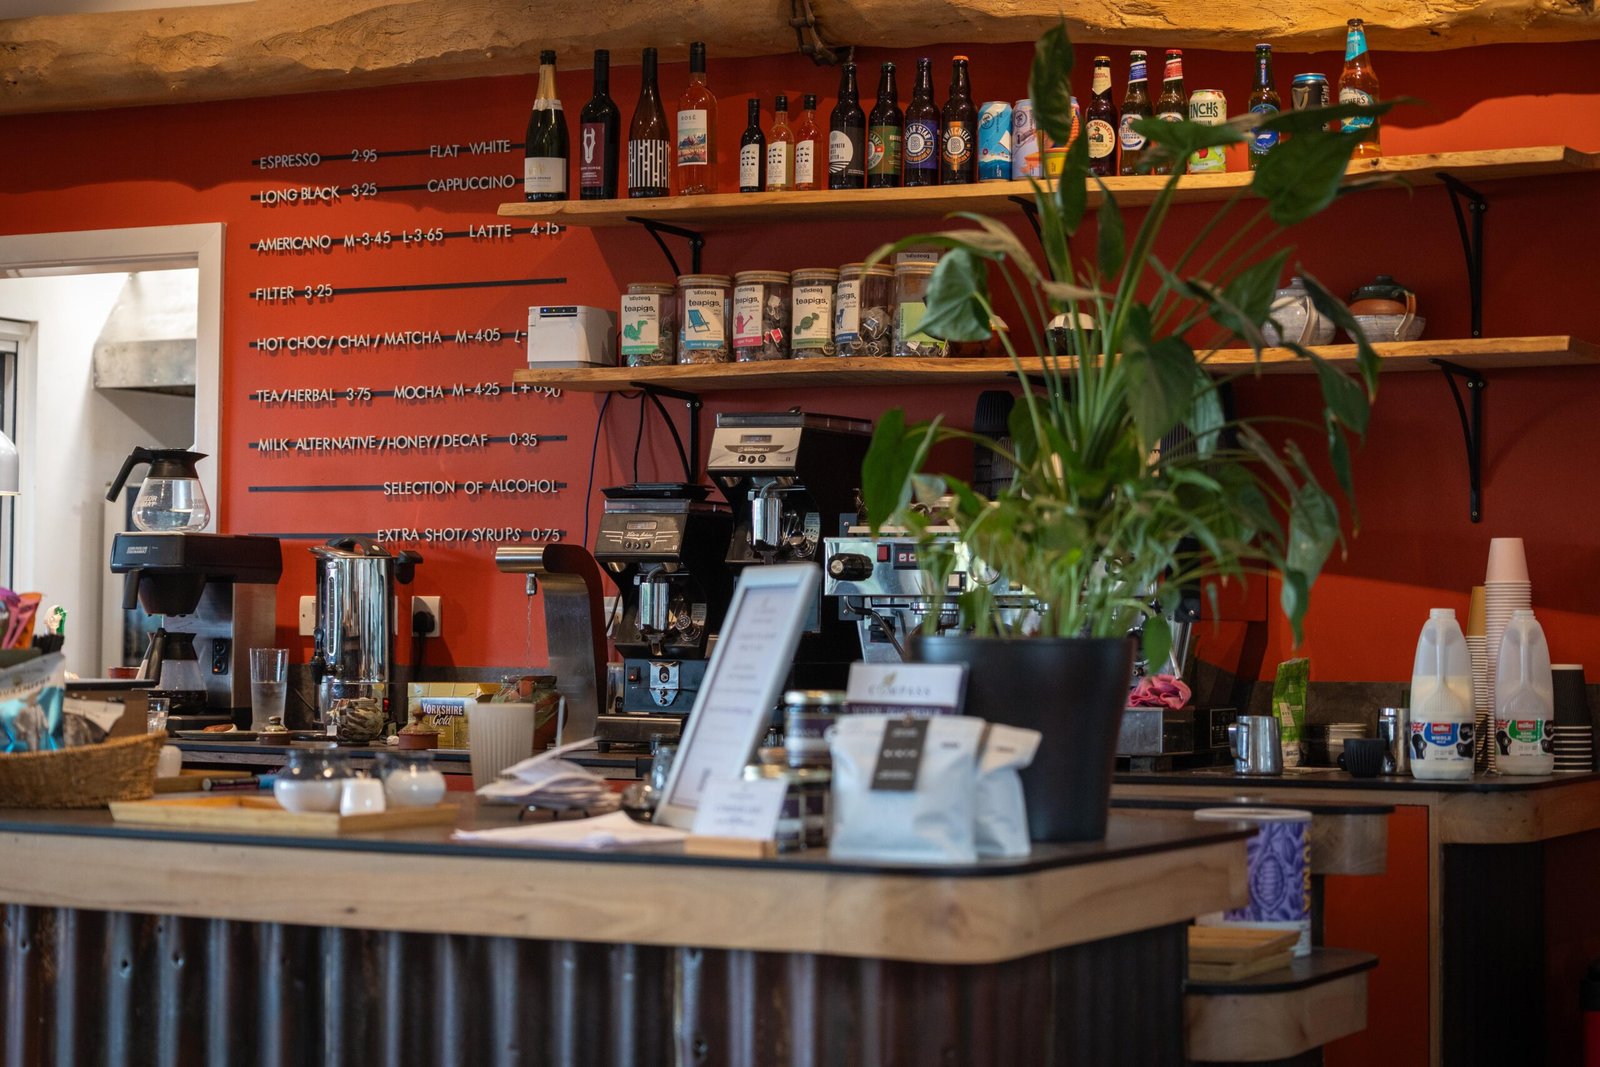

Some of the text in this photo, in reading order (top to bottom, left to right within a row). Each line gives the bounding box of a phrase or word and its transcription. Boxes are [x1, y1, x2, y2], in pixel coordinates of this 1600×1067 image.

[430, 139, 511, 158] FLAT WHITE
[259, 152, 321, 170] ESPRESSO
[427, 174, 515, 193] CAPPUCCINO
[260, 188, 298, 204] LONG
[300, 185, 340, 201] BLACK
[469, 224, 511, 238] LATTE
[256, 234, 331, 252] AMERICANO
[255, 285, 295, 301] FILTER
[256, 336, 285, 351] HOT
[383, 330, 442, 346] MATCHA
[255, 387, 336, 403] TEA/HERBAL
[393, 384, 444, 400] MOCHA
[257, 437, 289, 452] MILK
[383, 478, 558, 496] SELECTION OF ALCOHOL
[376, 527, 420, 543] EXTRA
[422, 702, 463, 715] YORKSHIRE
[433, 714, 453, 728] Gold
